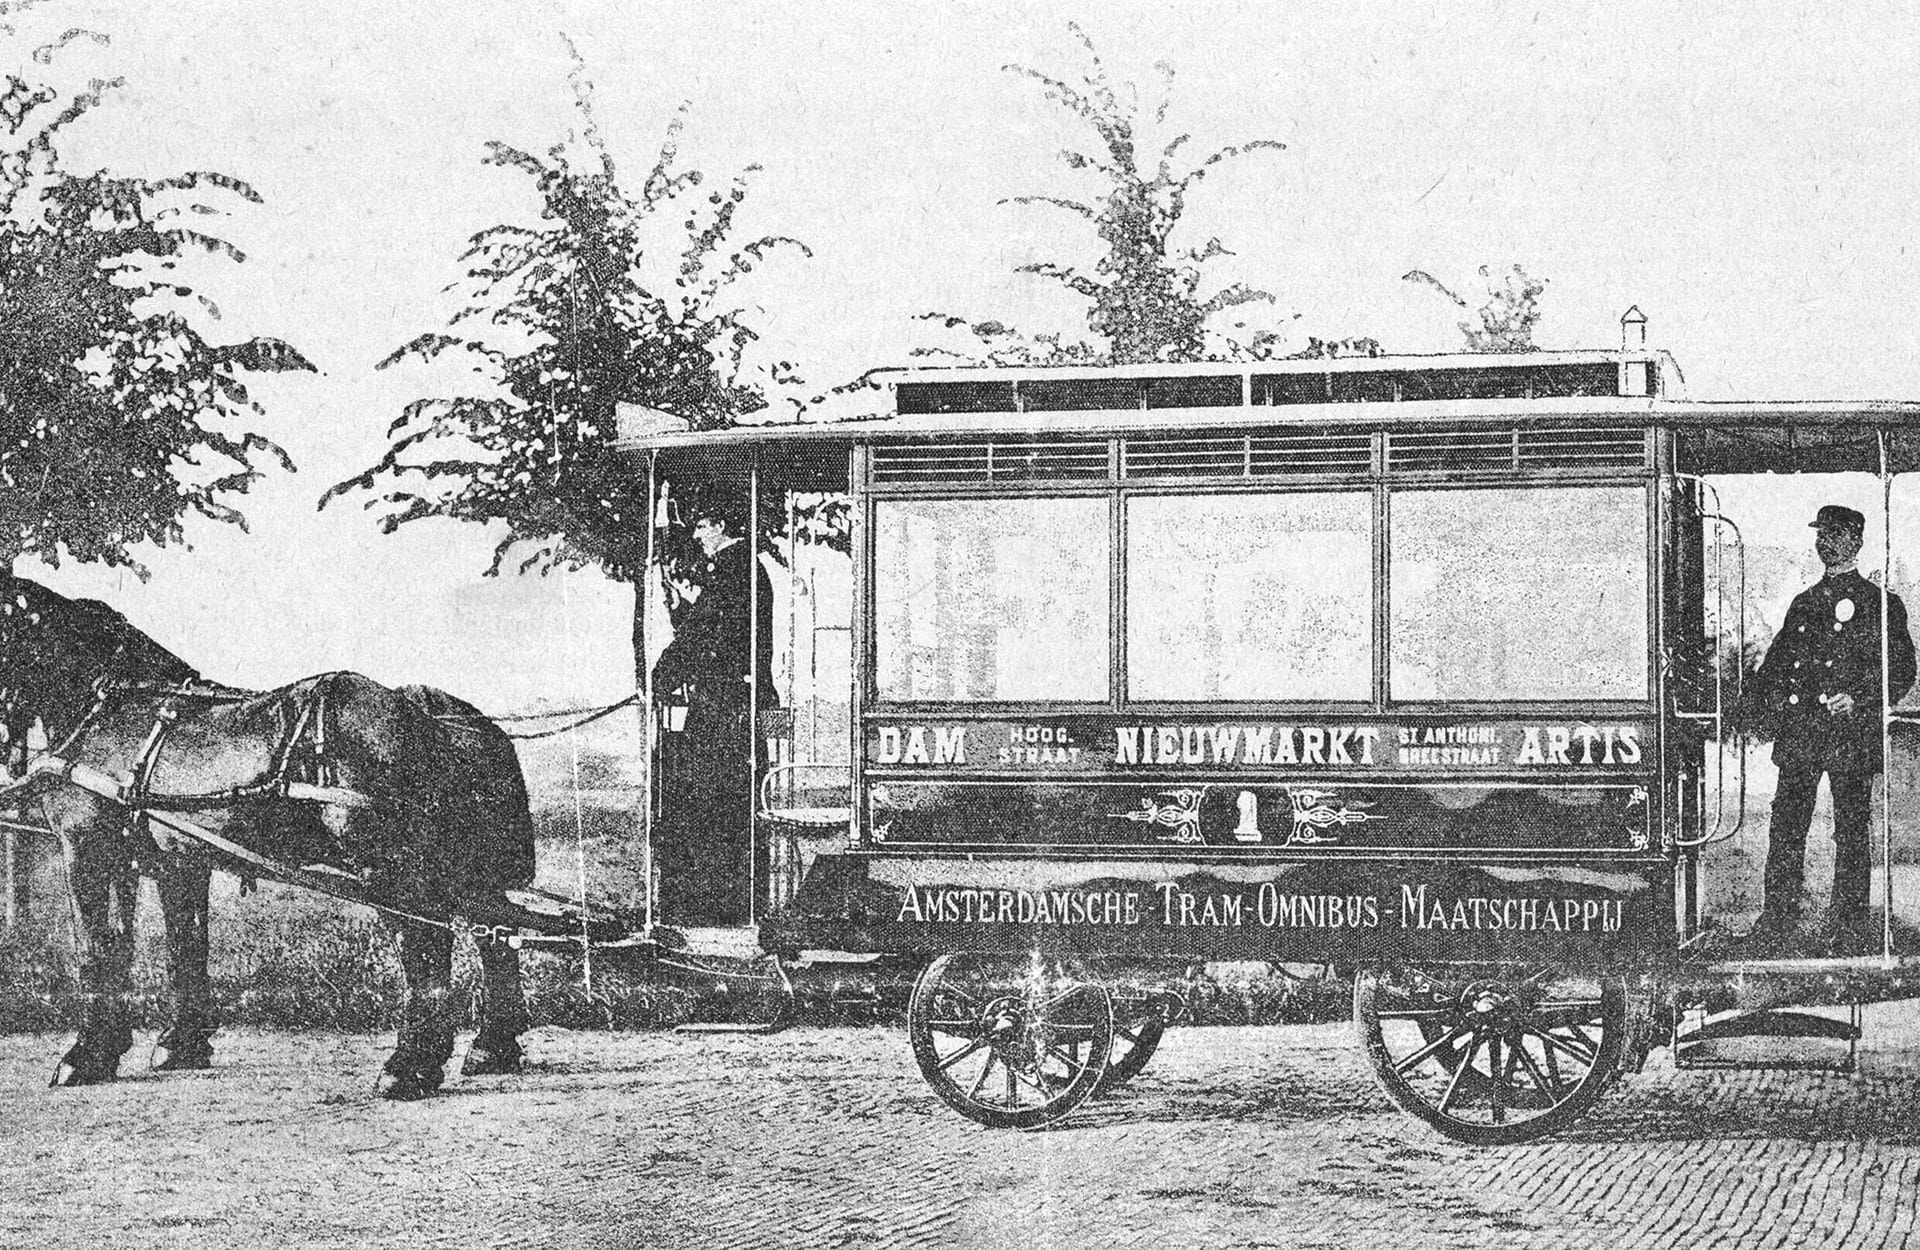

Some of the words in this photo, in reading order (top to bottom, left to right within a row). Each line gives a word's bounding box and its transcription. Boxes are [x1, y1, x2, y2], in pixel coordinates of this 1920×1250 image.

[877, 726, 967, 764] DAM
[999, 746, 1080, 764] STRAAT
[1114, 726, 1380, 765] NIEUWMARKT
[1516, 725, 1642, 765] ARTIS
[1233, 790, 1262, 842] 1
[897, 882, 1140, 925] AMSTERDAMSCHE
